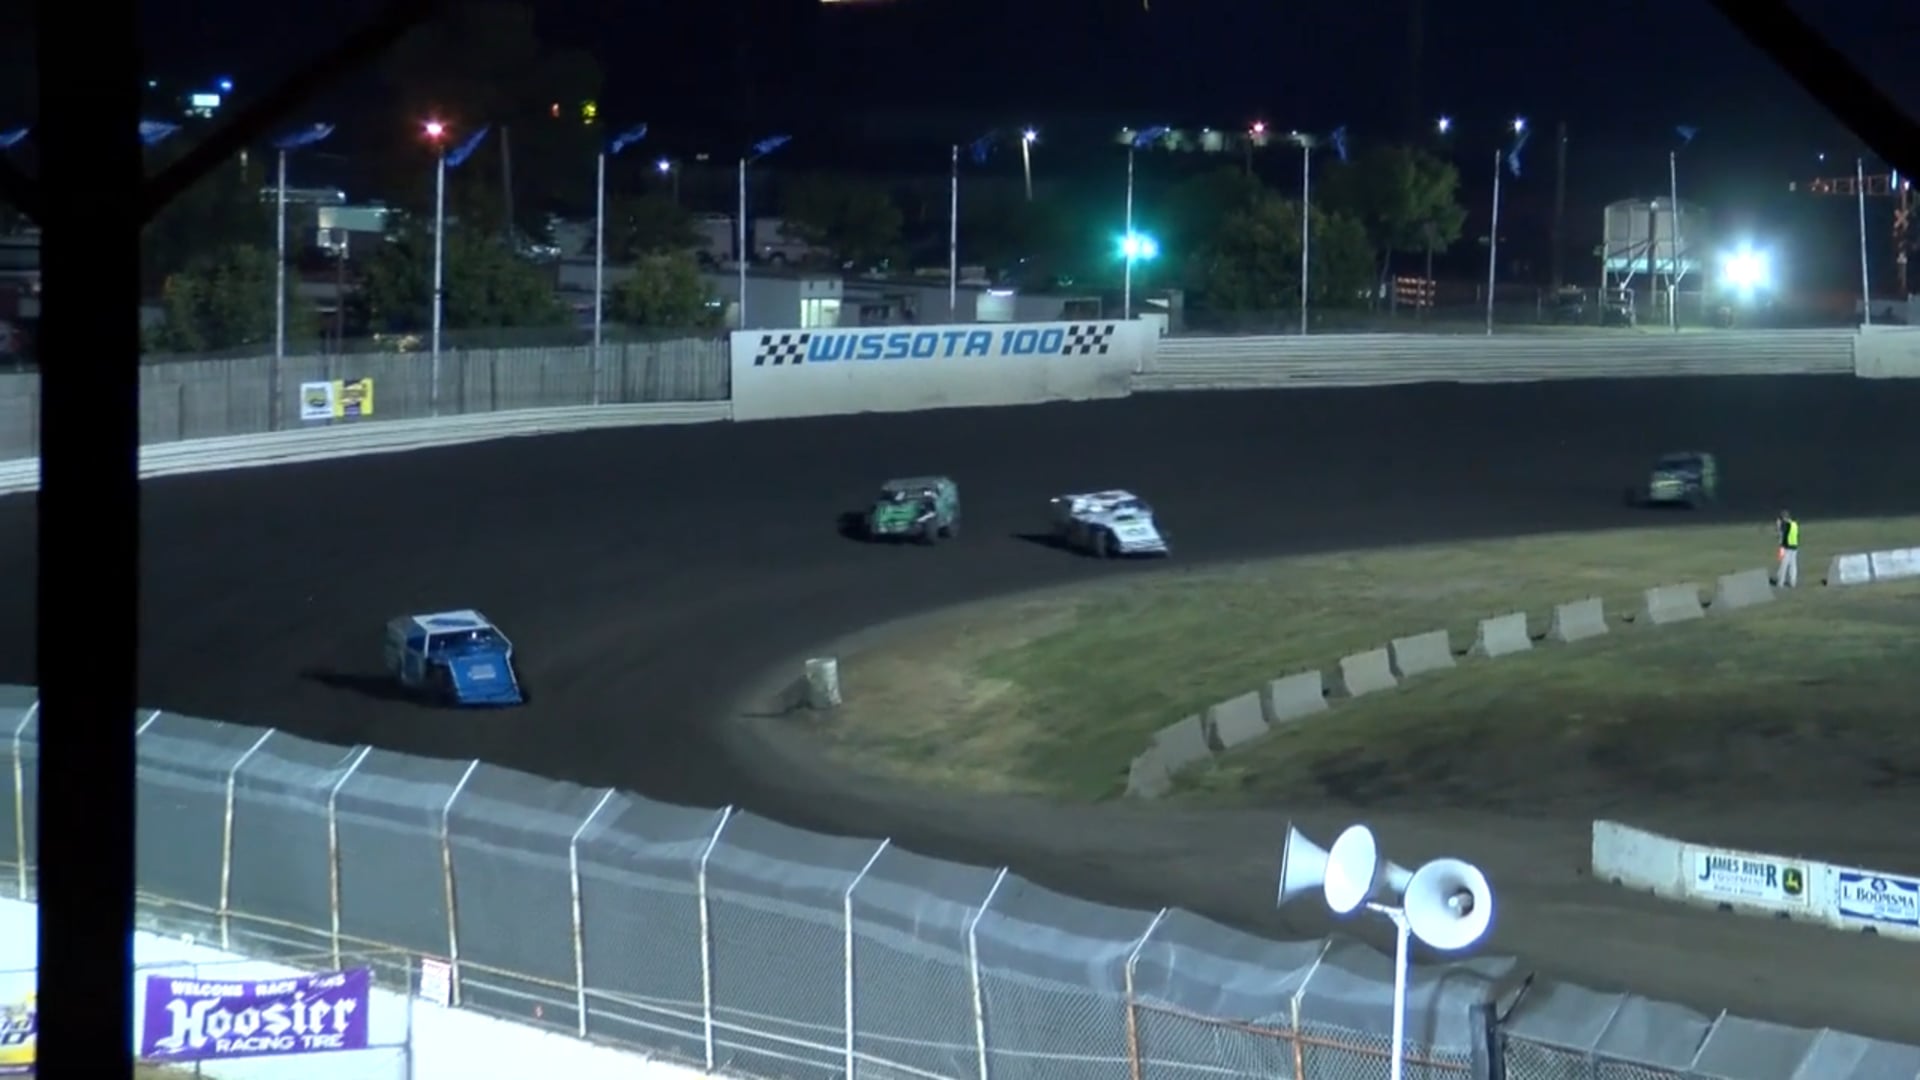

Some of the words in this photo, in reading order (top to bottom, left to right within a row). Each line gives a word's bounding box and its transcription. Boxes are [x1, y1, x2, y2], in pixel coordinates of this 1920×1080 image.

[807, 330, 993, 362] WISSOTA
[1001, 329, 1064, 356] 100
[1699, 855, 1739, 881] JAMES
[1742, 860, 1778, 889] RIVER
[170, 980, 243, 997] WELCOME
[155, 991, 358, 1050] Hoosier
[215, 1035, 295, 1053] RACING
[301, 1033, 345, 1050] TIRE
